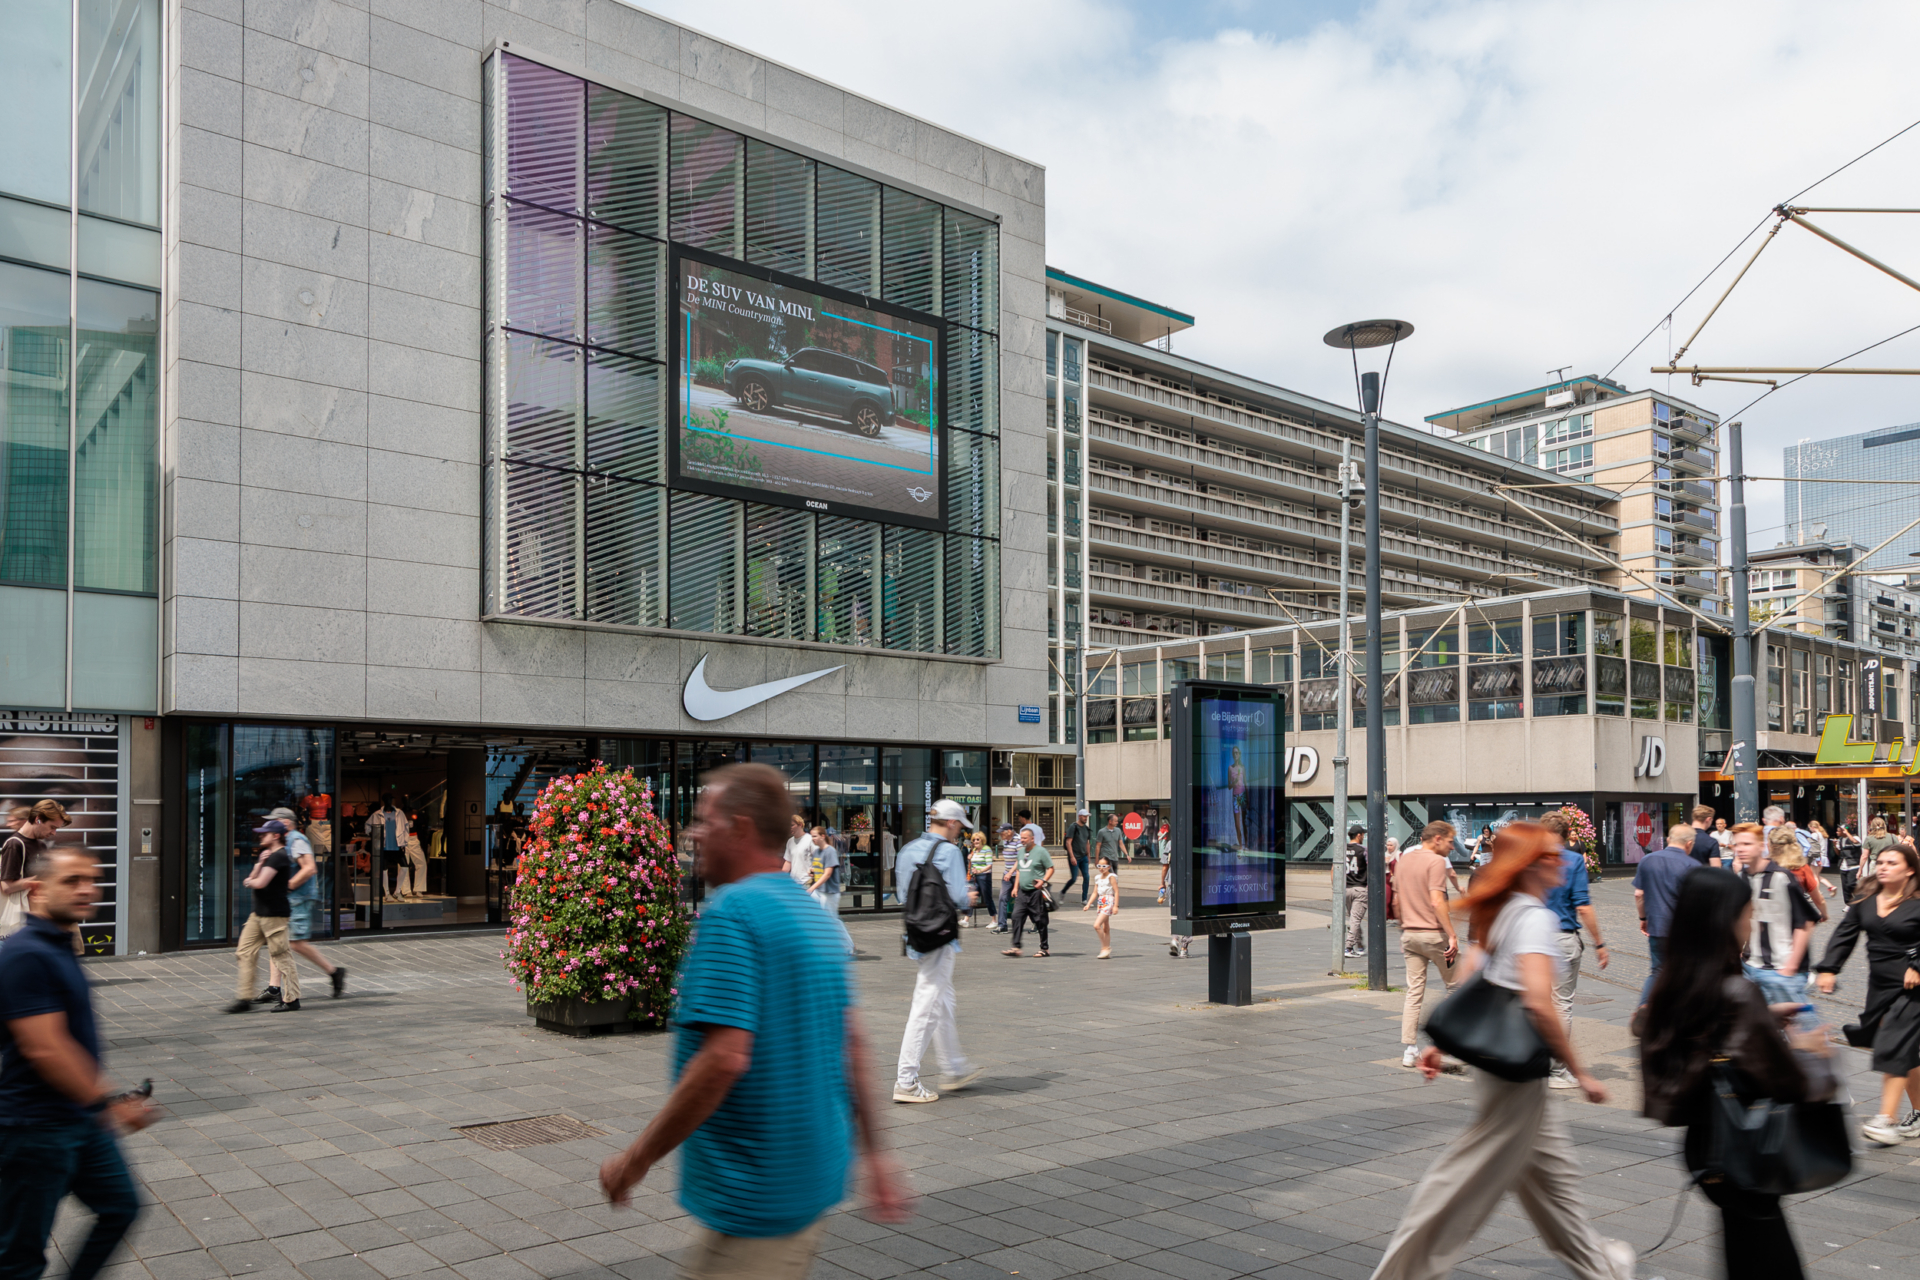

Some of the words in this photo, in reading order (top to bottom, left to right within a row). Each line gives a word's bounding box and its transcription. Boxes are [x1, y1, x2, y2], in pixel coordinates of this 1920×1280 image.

[687, 275, 708, 293] DE
[712, 281, 742, 301] SUV
[746, 290, 775, 310] VAN
[779, 300, 816, 322] MINI.
[687, 292, 700, 304] De
[702, 297, 727, 311] MINI
[728, 303, 784, 326] Countryman.
[806, 500, 828, 510] OCEAN
[1863, 659, 1879, 670] JD
[18, 711, 116, 733] NOTHING
[1211, 711, 1221, 721] de
[1222, 711, 1253, 723] Bijenkorf
[1637, 736, 1666, 777] JD
[1125, 822, 1141, 830] SALE
[1638, 825, 1651, 833] SALE
[1208, 885, 1222, 894] TOT
[1223, 884, 1238, 894] 50%
[1239, 882, 1269, 893] KORTING
